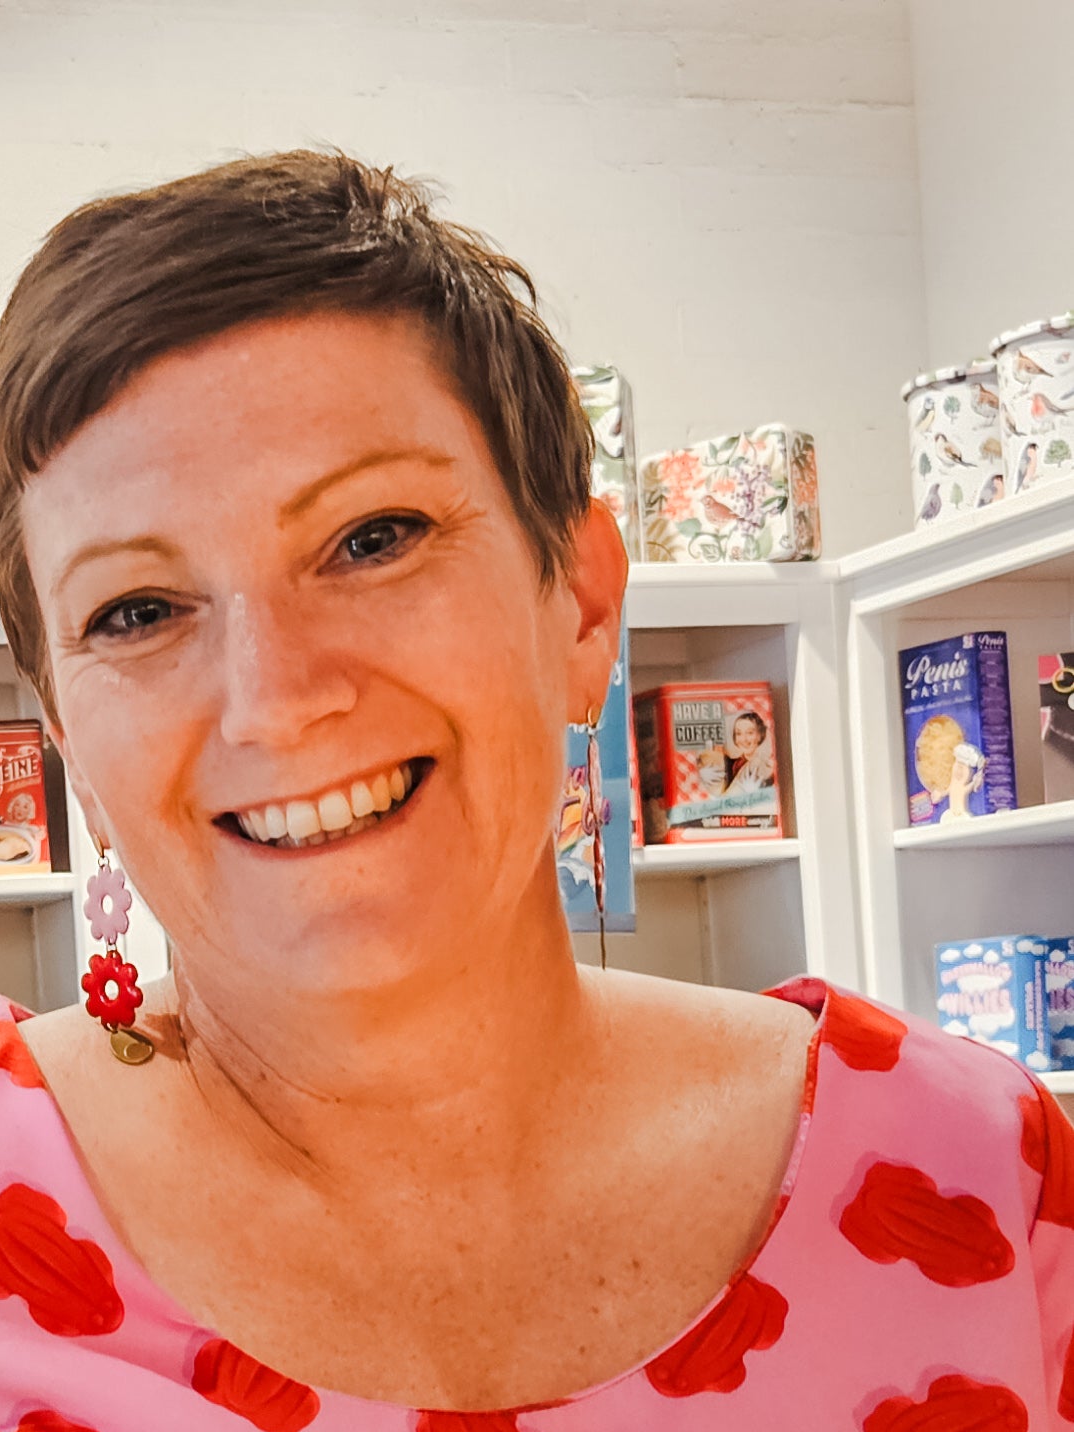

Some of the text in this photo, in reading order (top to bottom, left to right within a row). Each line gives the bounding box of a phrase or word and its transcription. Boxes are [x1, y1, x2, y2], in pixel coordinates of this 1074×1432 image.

[905, 651, 968, 688] Penis
[911, 680, 962, 700] PASTA
[673, 702, 722, 720] HAVE A
[675, 725, 723, 742] COFFEE
